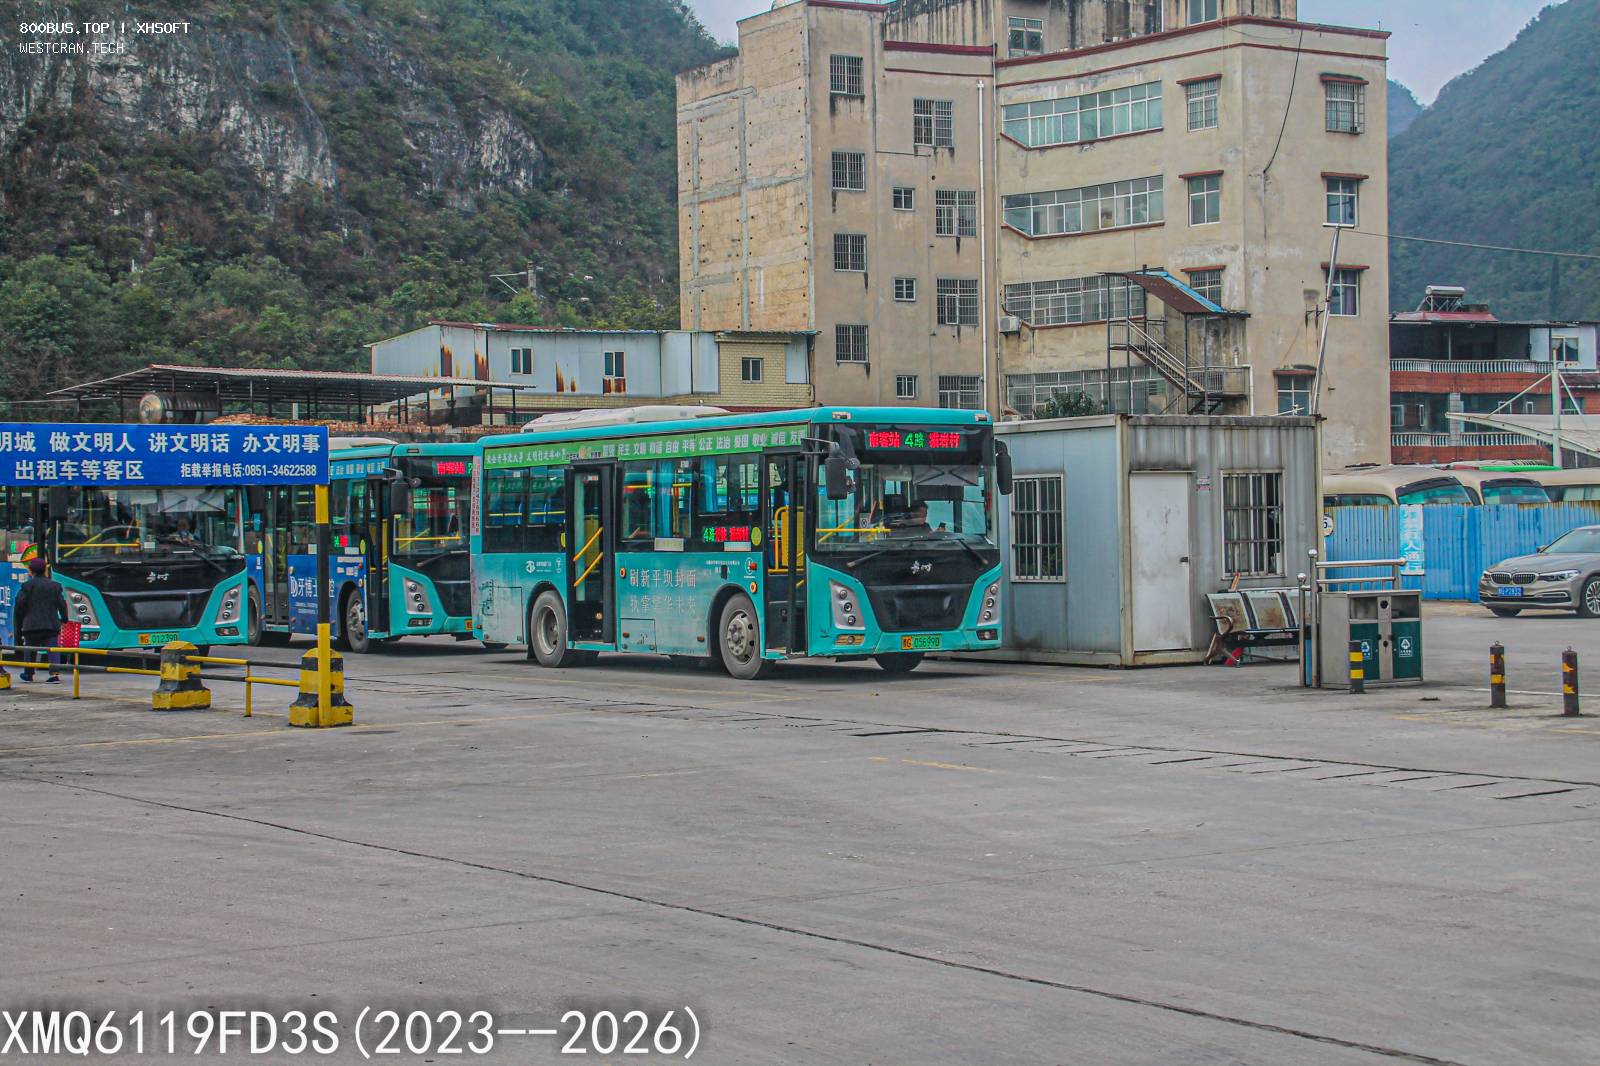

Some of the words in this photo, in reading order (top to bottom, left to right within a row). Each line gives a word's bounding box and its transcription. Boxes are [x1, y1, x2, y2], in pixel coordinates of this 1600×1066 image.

[49, 431, 136, 453] 做文明人
[147, 432, 230, 454] 讲文明话
[242, 433, 321, 454] 办文明事
[15, 459, 144, 481] 出租车等客区
